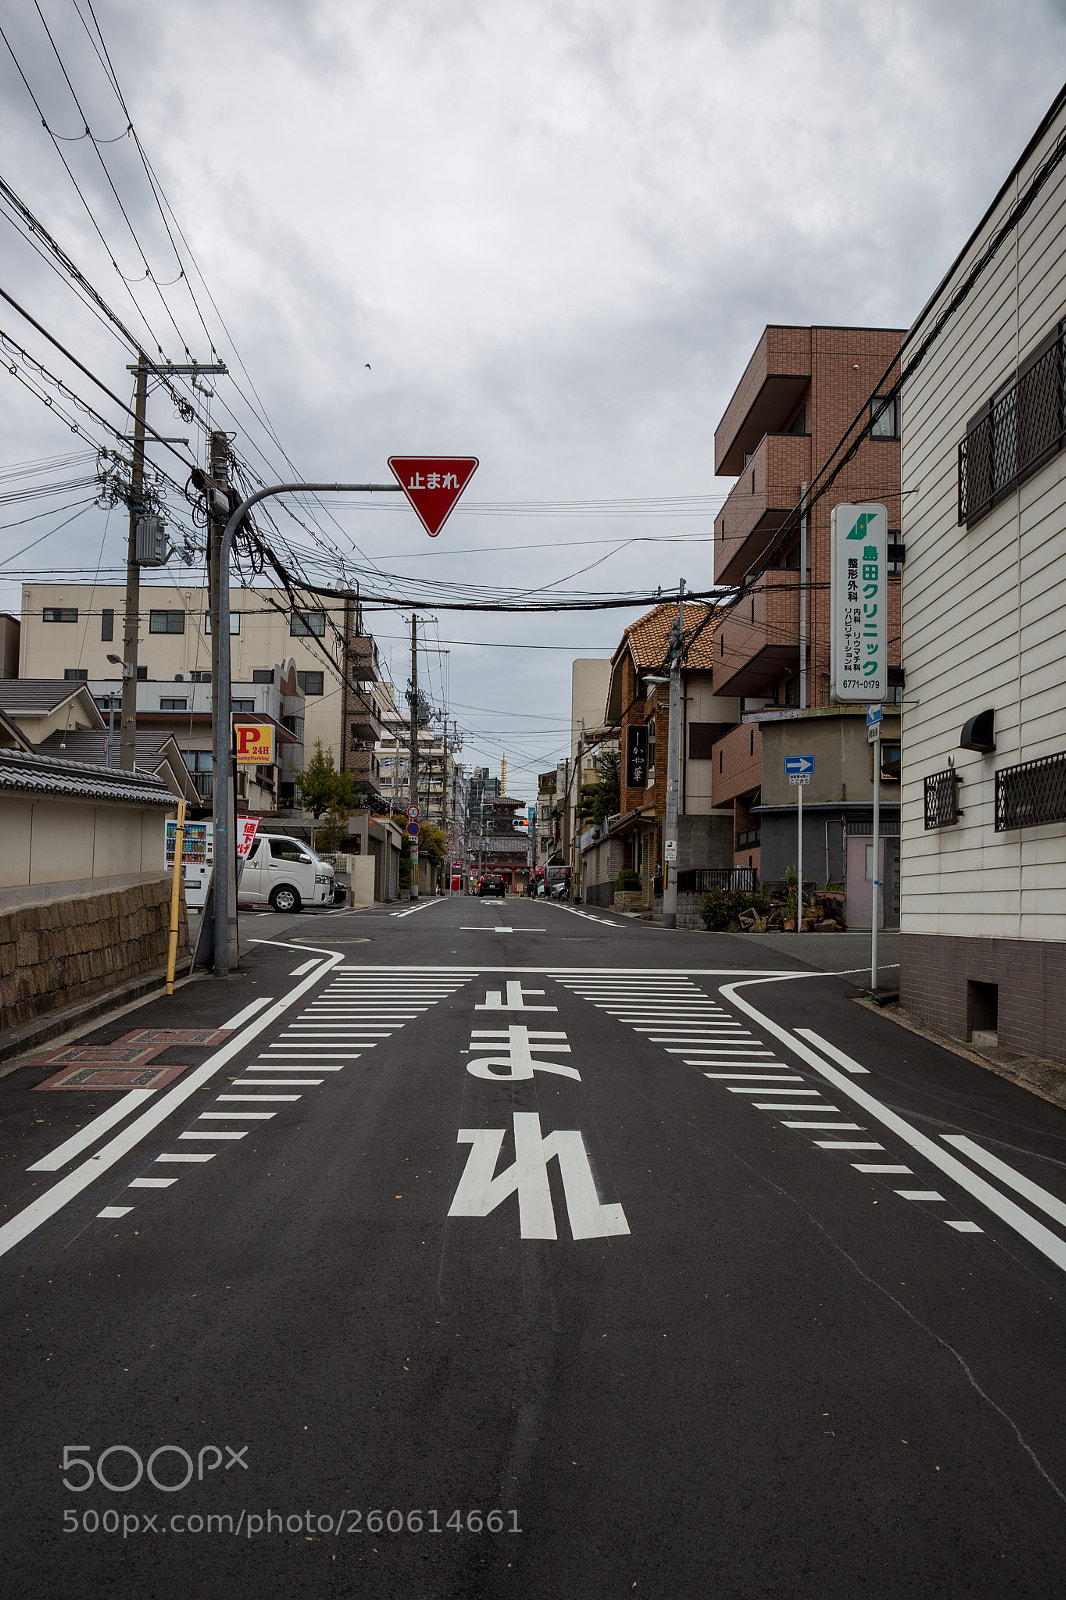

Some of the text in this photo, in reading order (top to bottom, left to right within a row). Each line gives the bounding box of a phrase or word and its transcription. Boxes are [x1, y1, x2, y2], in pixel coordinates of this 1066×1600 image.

[408, 472, 460, 489] 止まれ
[847, 558, 859, 602] 整形外科
[862, 545, 879, 676] 島田クリニック
[844, 607, 853, 672] リハビリテーション科
[853, 608, 862, 672] 内科 リウマチ科
[842, 680, 880, 689] 6771-0179
[237, 727, 261, 754] P
[252, 746, 270, 755] 24H
[447, 980, 631, 1240] 止まれ
